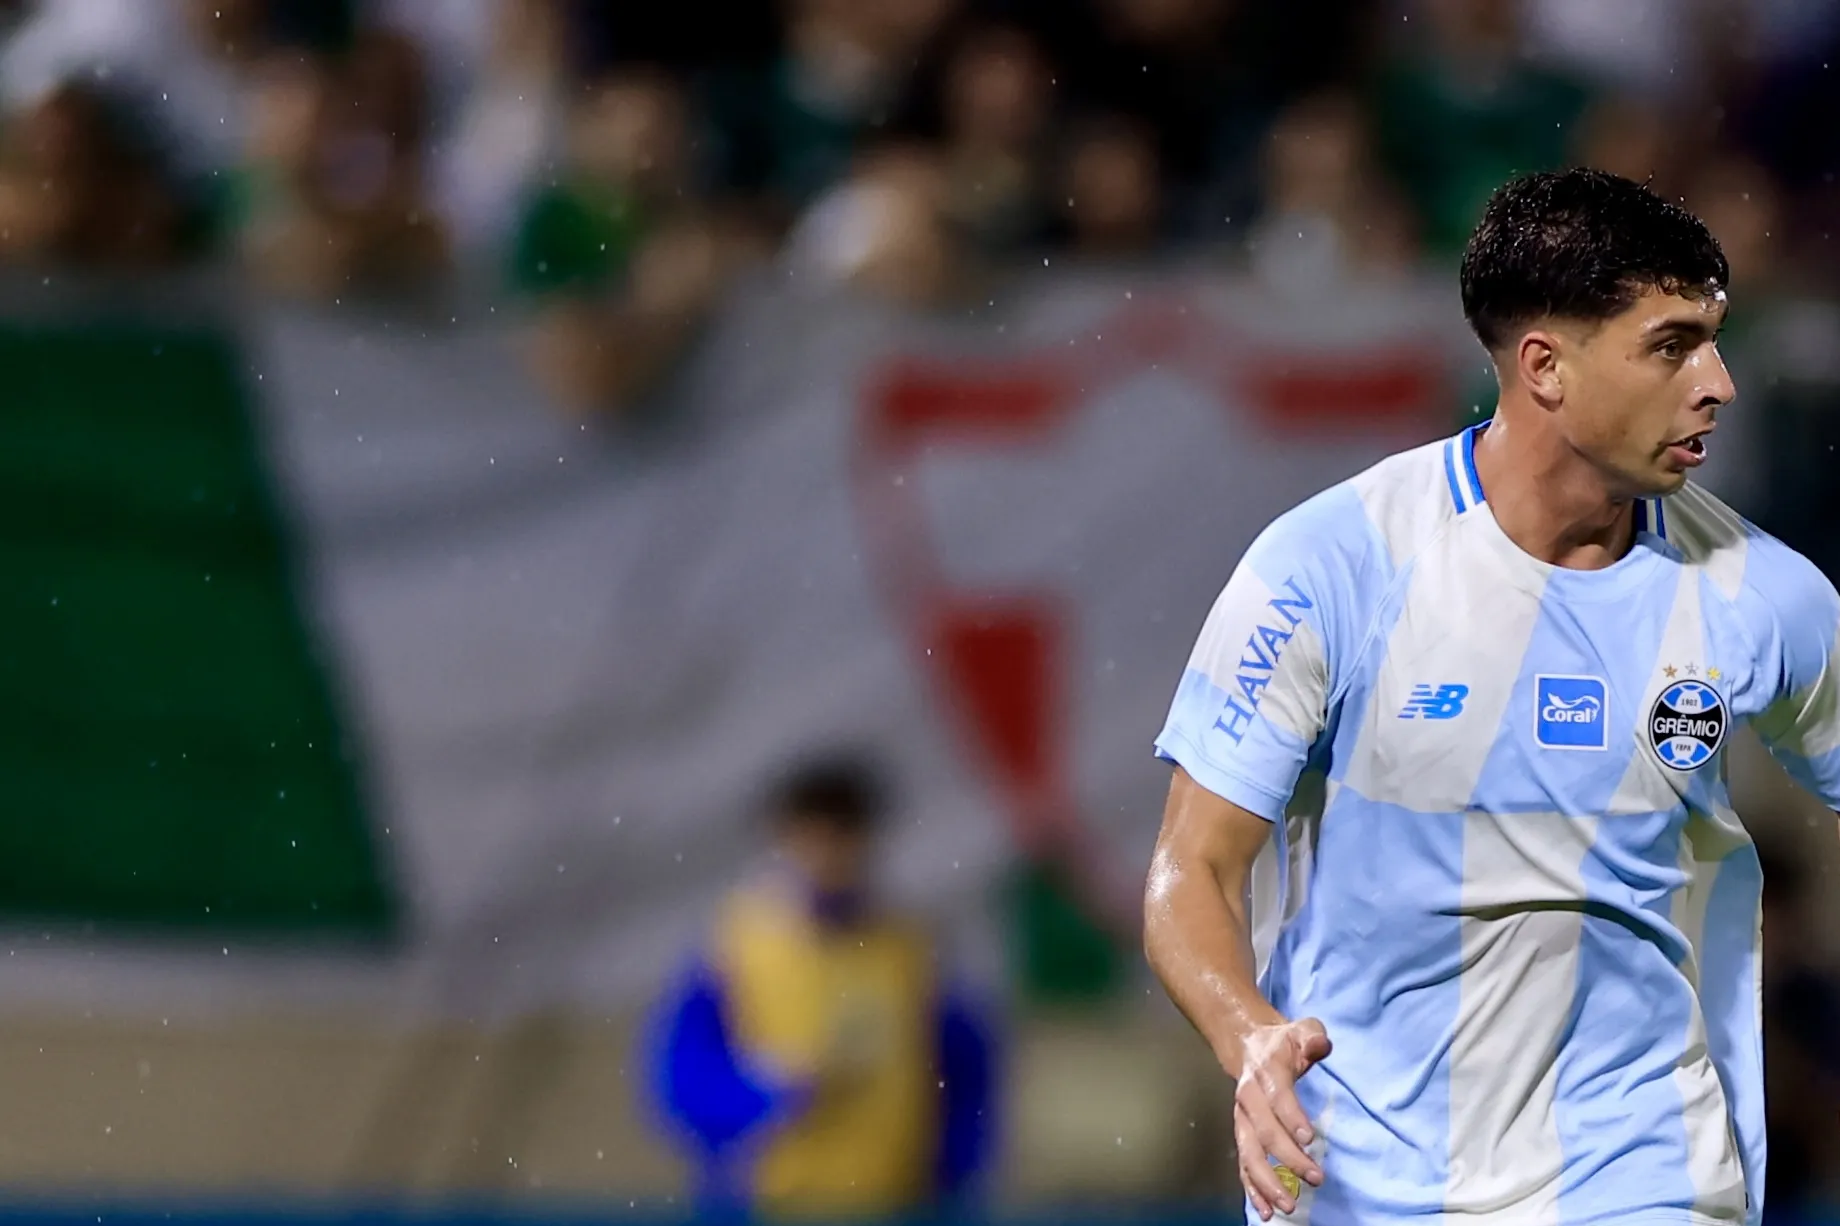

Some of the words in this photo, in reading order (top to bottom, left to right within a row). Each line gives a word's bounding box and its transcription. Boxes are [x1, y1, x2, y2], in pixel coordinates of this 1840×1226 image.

[1212, 575, 1313, 748] HAVAN
[1542, 705, 1591, 724] Coral
[1653, 714, 1720, 738] GRÊMIO
